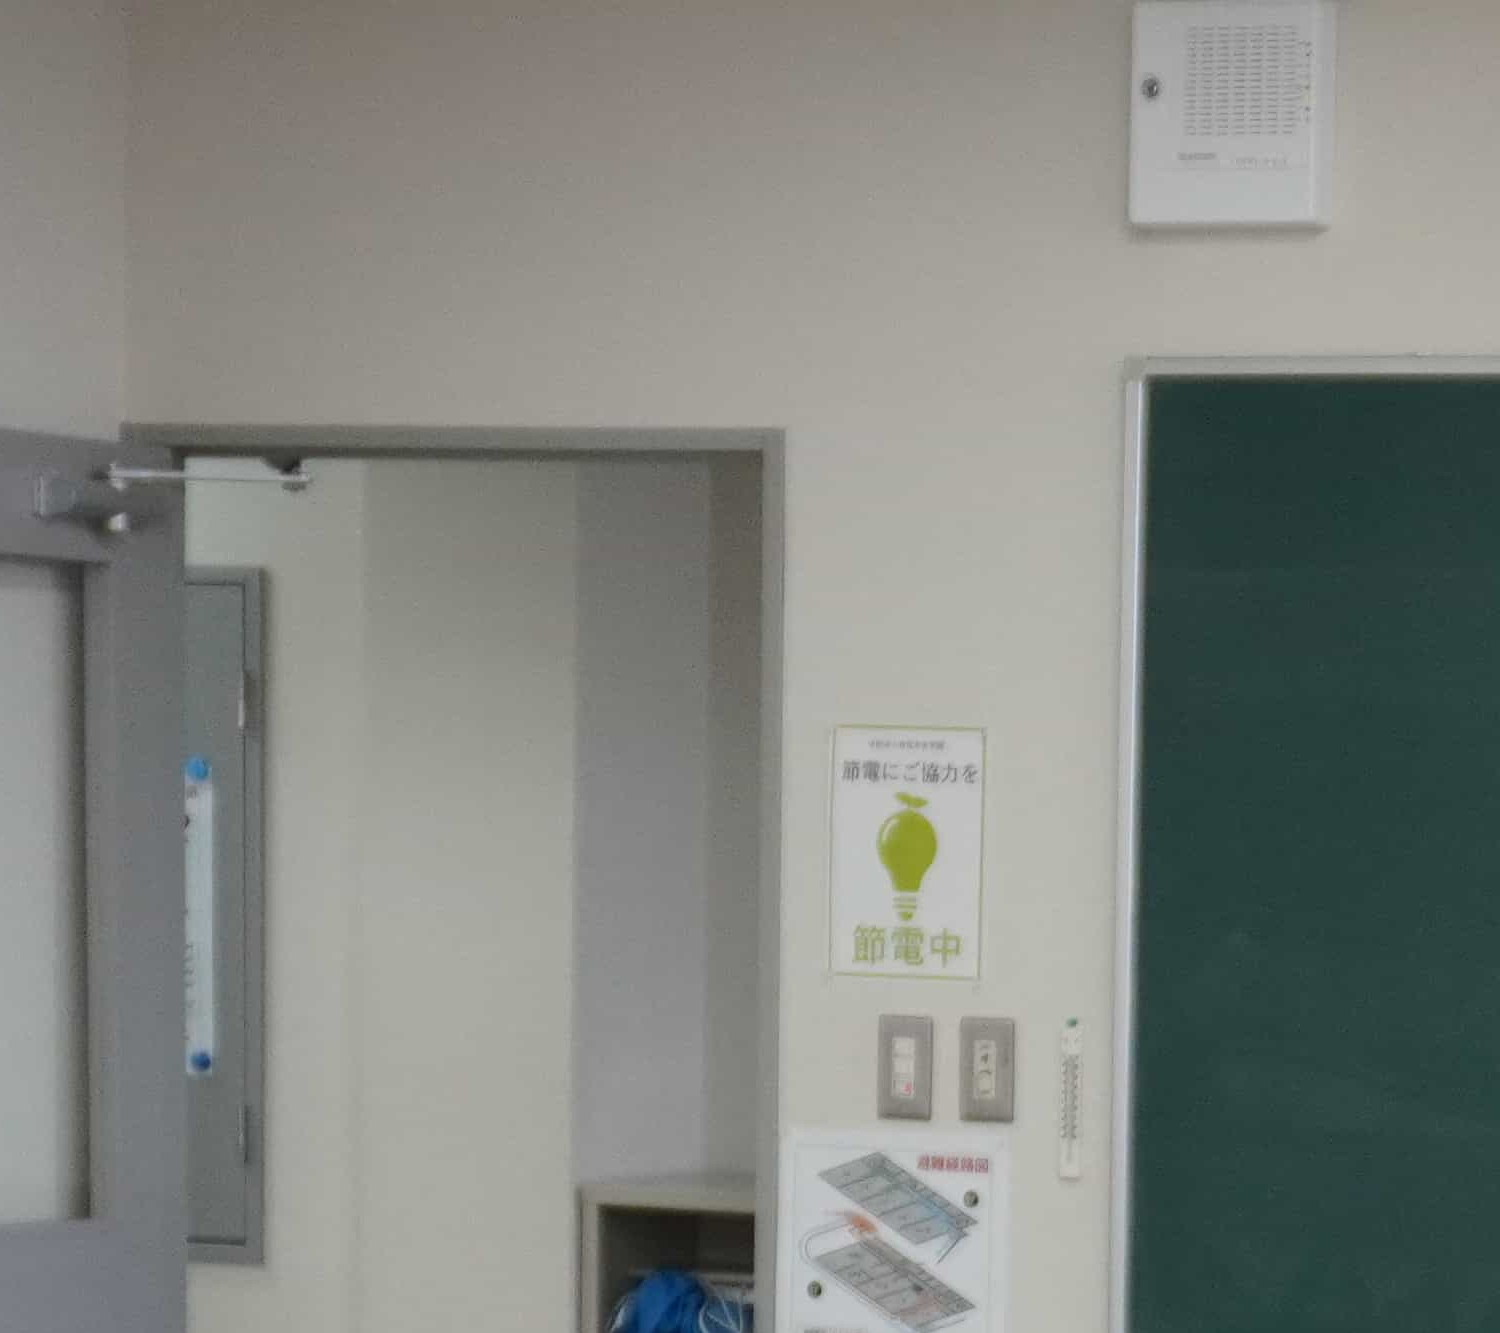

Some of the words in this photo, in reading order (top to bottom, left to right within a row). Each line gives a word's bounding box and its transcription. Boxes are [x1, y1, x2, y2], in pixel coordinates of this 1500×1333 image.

[841, 760, 979, 784] 節電にご協力を
[852, 925, 963, 967] 節電中
